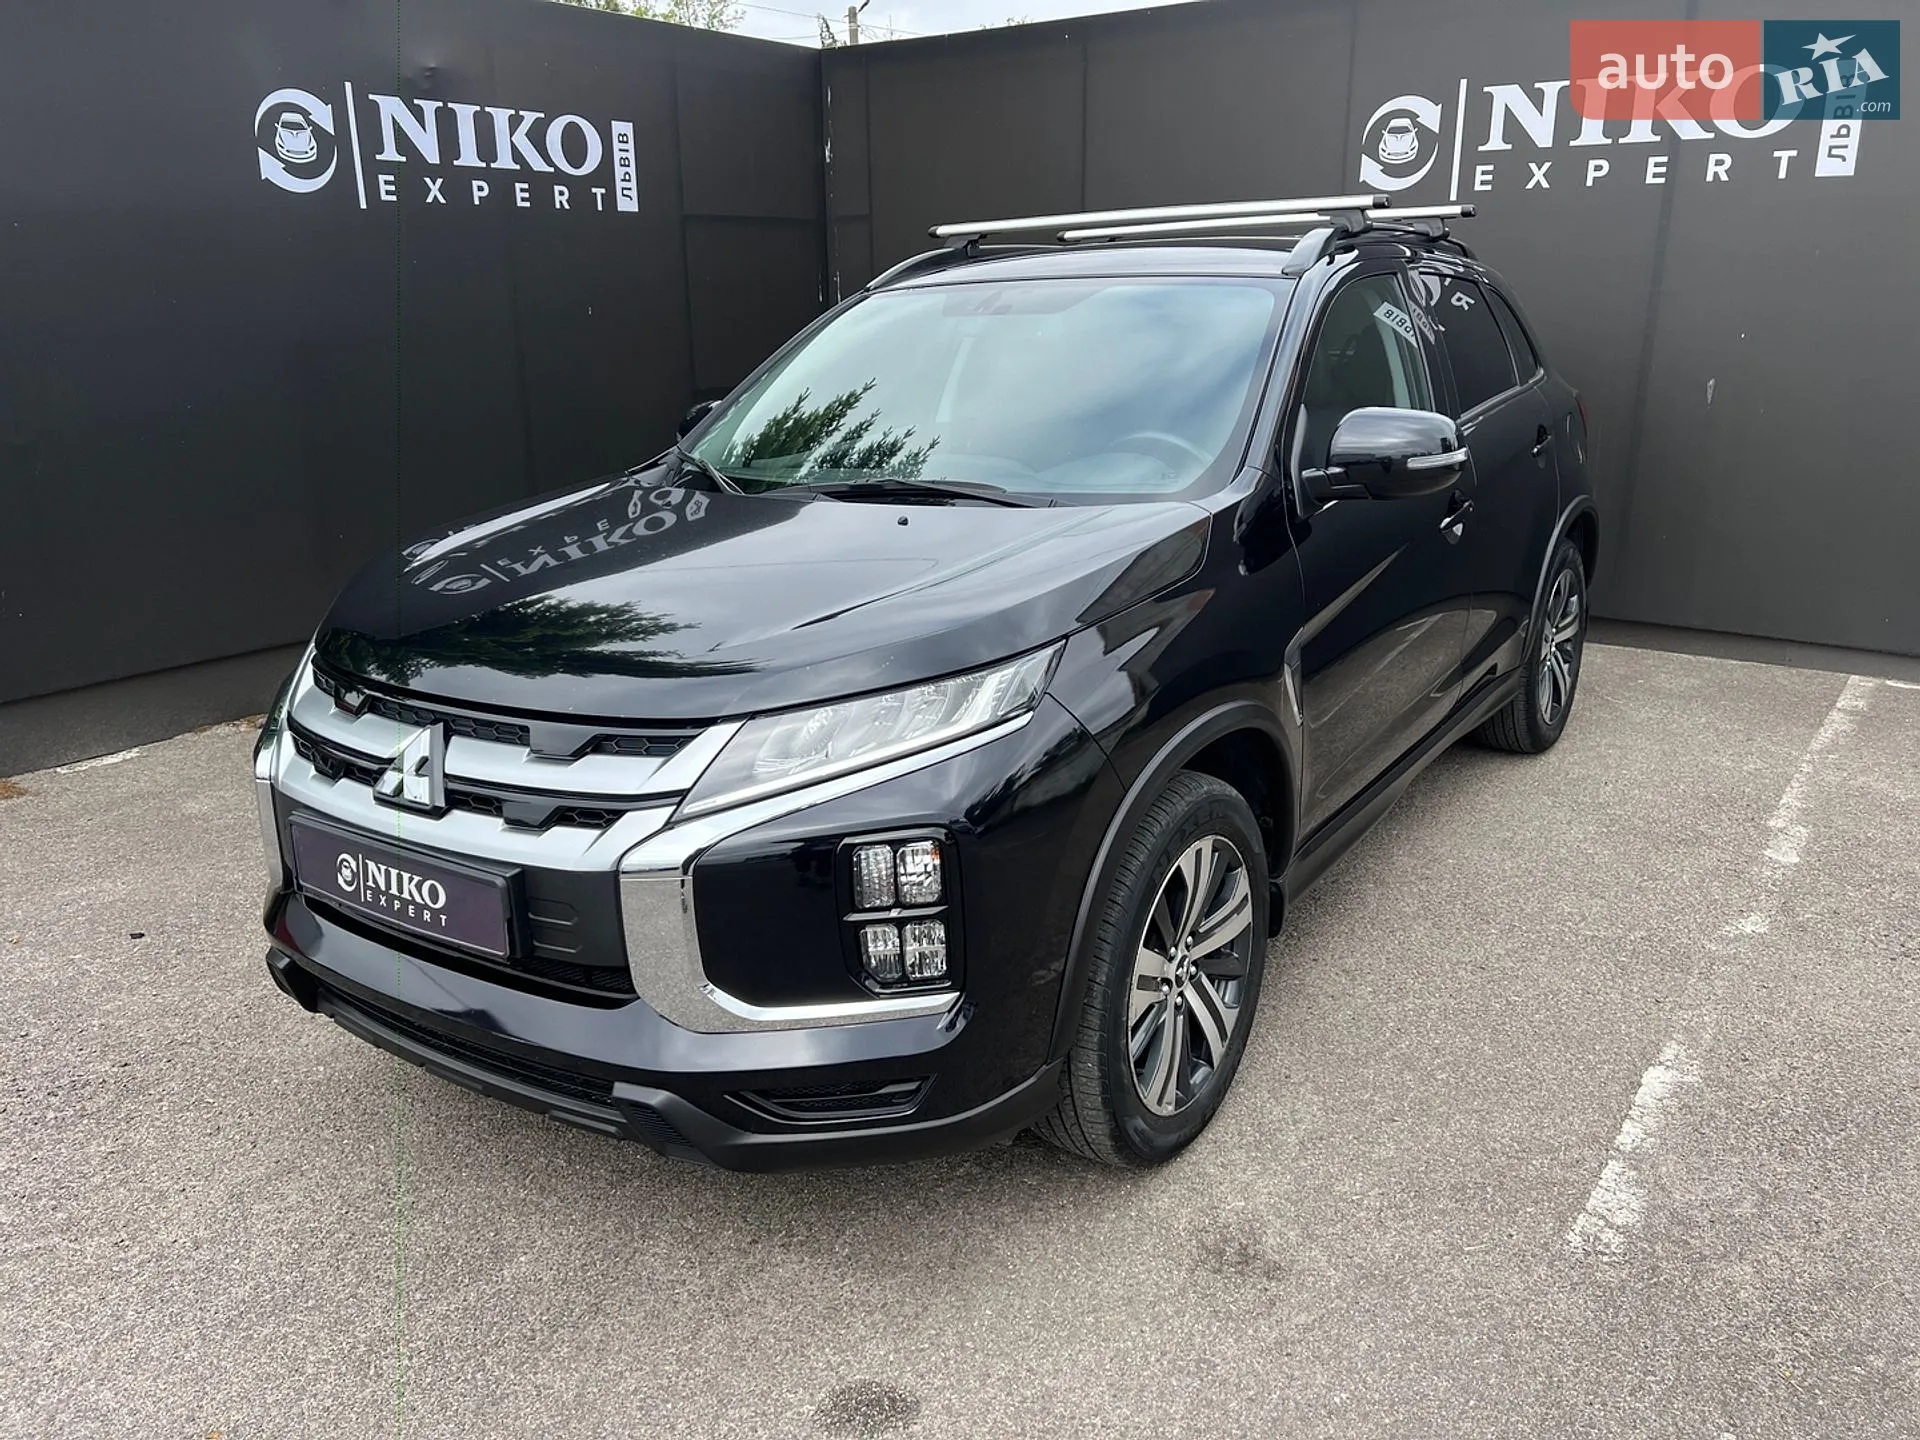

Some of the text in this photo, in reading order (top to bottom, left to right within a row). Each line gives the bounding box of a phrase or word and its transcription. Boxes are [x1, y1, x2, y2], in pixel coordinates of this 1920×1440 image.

[1479, 63, 1804, 151] NIKO
[368, 94, 602, 176] NIKO
[379, 174, 605, 210] EXPERT
[1474, 149, 1798, 191] EXPERT
[365, 859, 447, 909] NIKO
[366, 889, 447, 927] EXPERT
